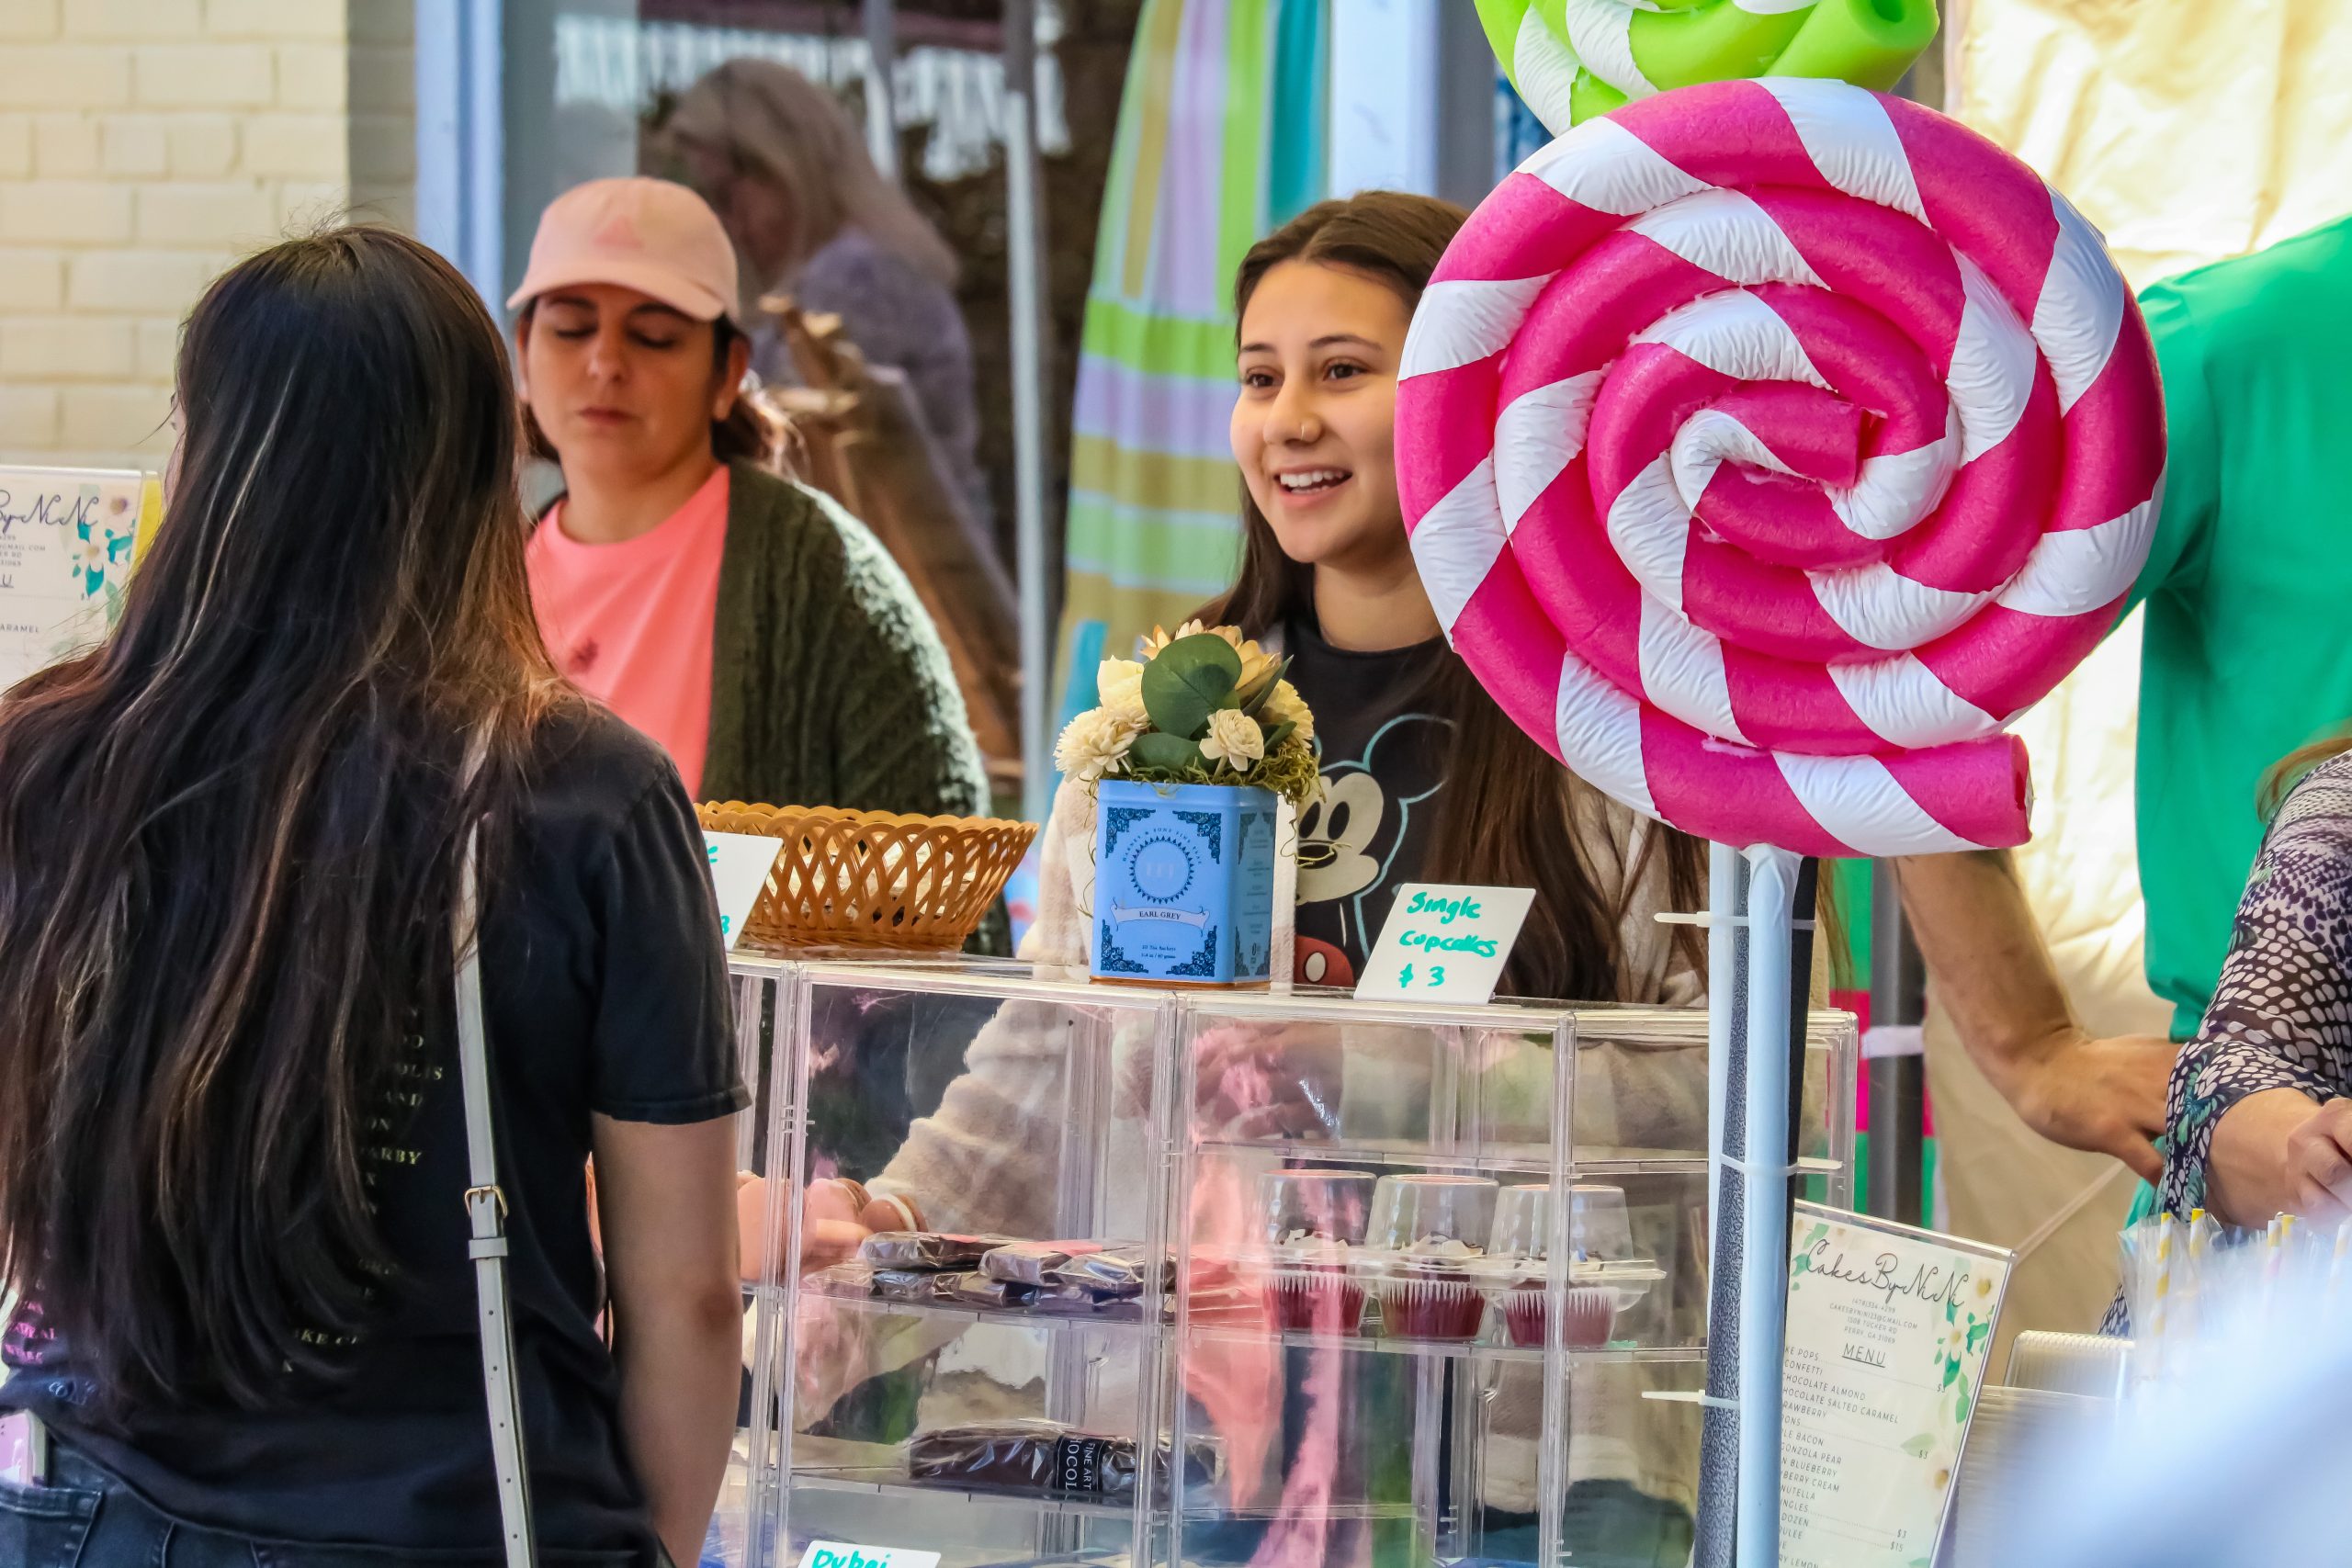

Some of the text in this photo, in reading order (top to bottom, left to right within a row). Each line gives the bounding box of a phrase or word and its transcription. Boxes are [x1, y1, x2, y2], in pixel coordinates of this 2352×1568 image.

[1407, 891, 1482, 924] Single
[1399, 931, 1498, 957] Cupcakes
[1863, 1319, 1887, 1331] TUCKER
[1797, 1349, 1819, 1361] POPS
[1843, 1343, 1886, 1365] MENU
[1784, 1359, 1823, 1376] CONFETTI
[1831, 1385, 1866, 1401] ALMOND
[1827, 1398, 1858, 1413] SALTED
[1860, 1406, 1899, 1424] CARAMEL
[1795, 1433, 1824, 1447] BACON
[1821, 1452, 1842, 1465] PEAR
[1918, 1449, 1928, 1459] $3
[1082, 1442, 1096, 1490] FINE ART
[1790, 1458, 1838, 1477] BLUEBERRY
[1781, 1484, 1815, 1500] NUTELLA
[1812, 1477, 1840, 1493] CREAM
[1781, 1512, 1904, 1552] DOZEN $15
[1897, 1529, 1907, 1539] $3
